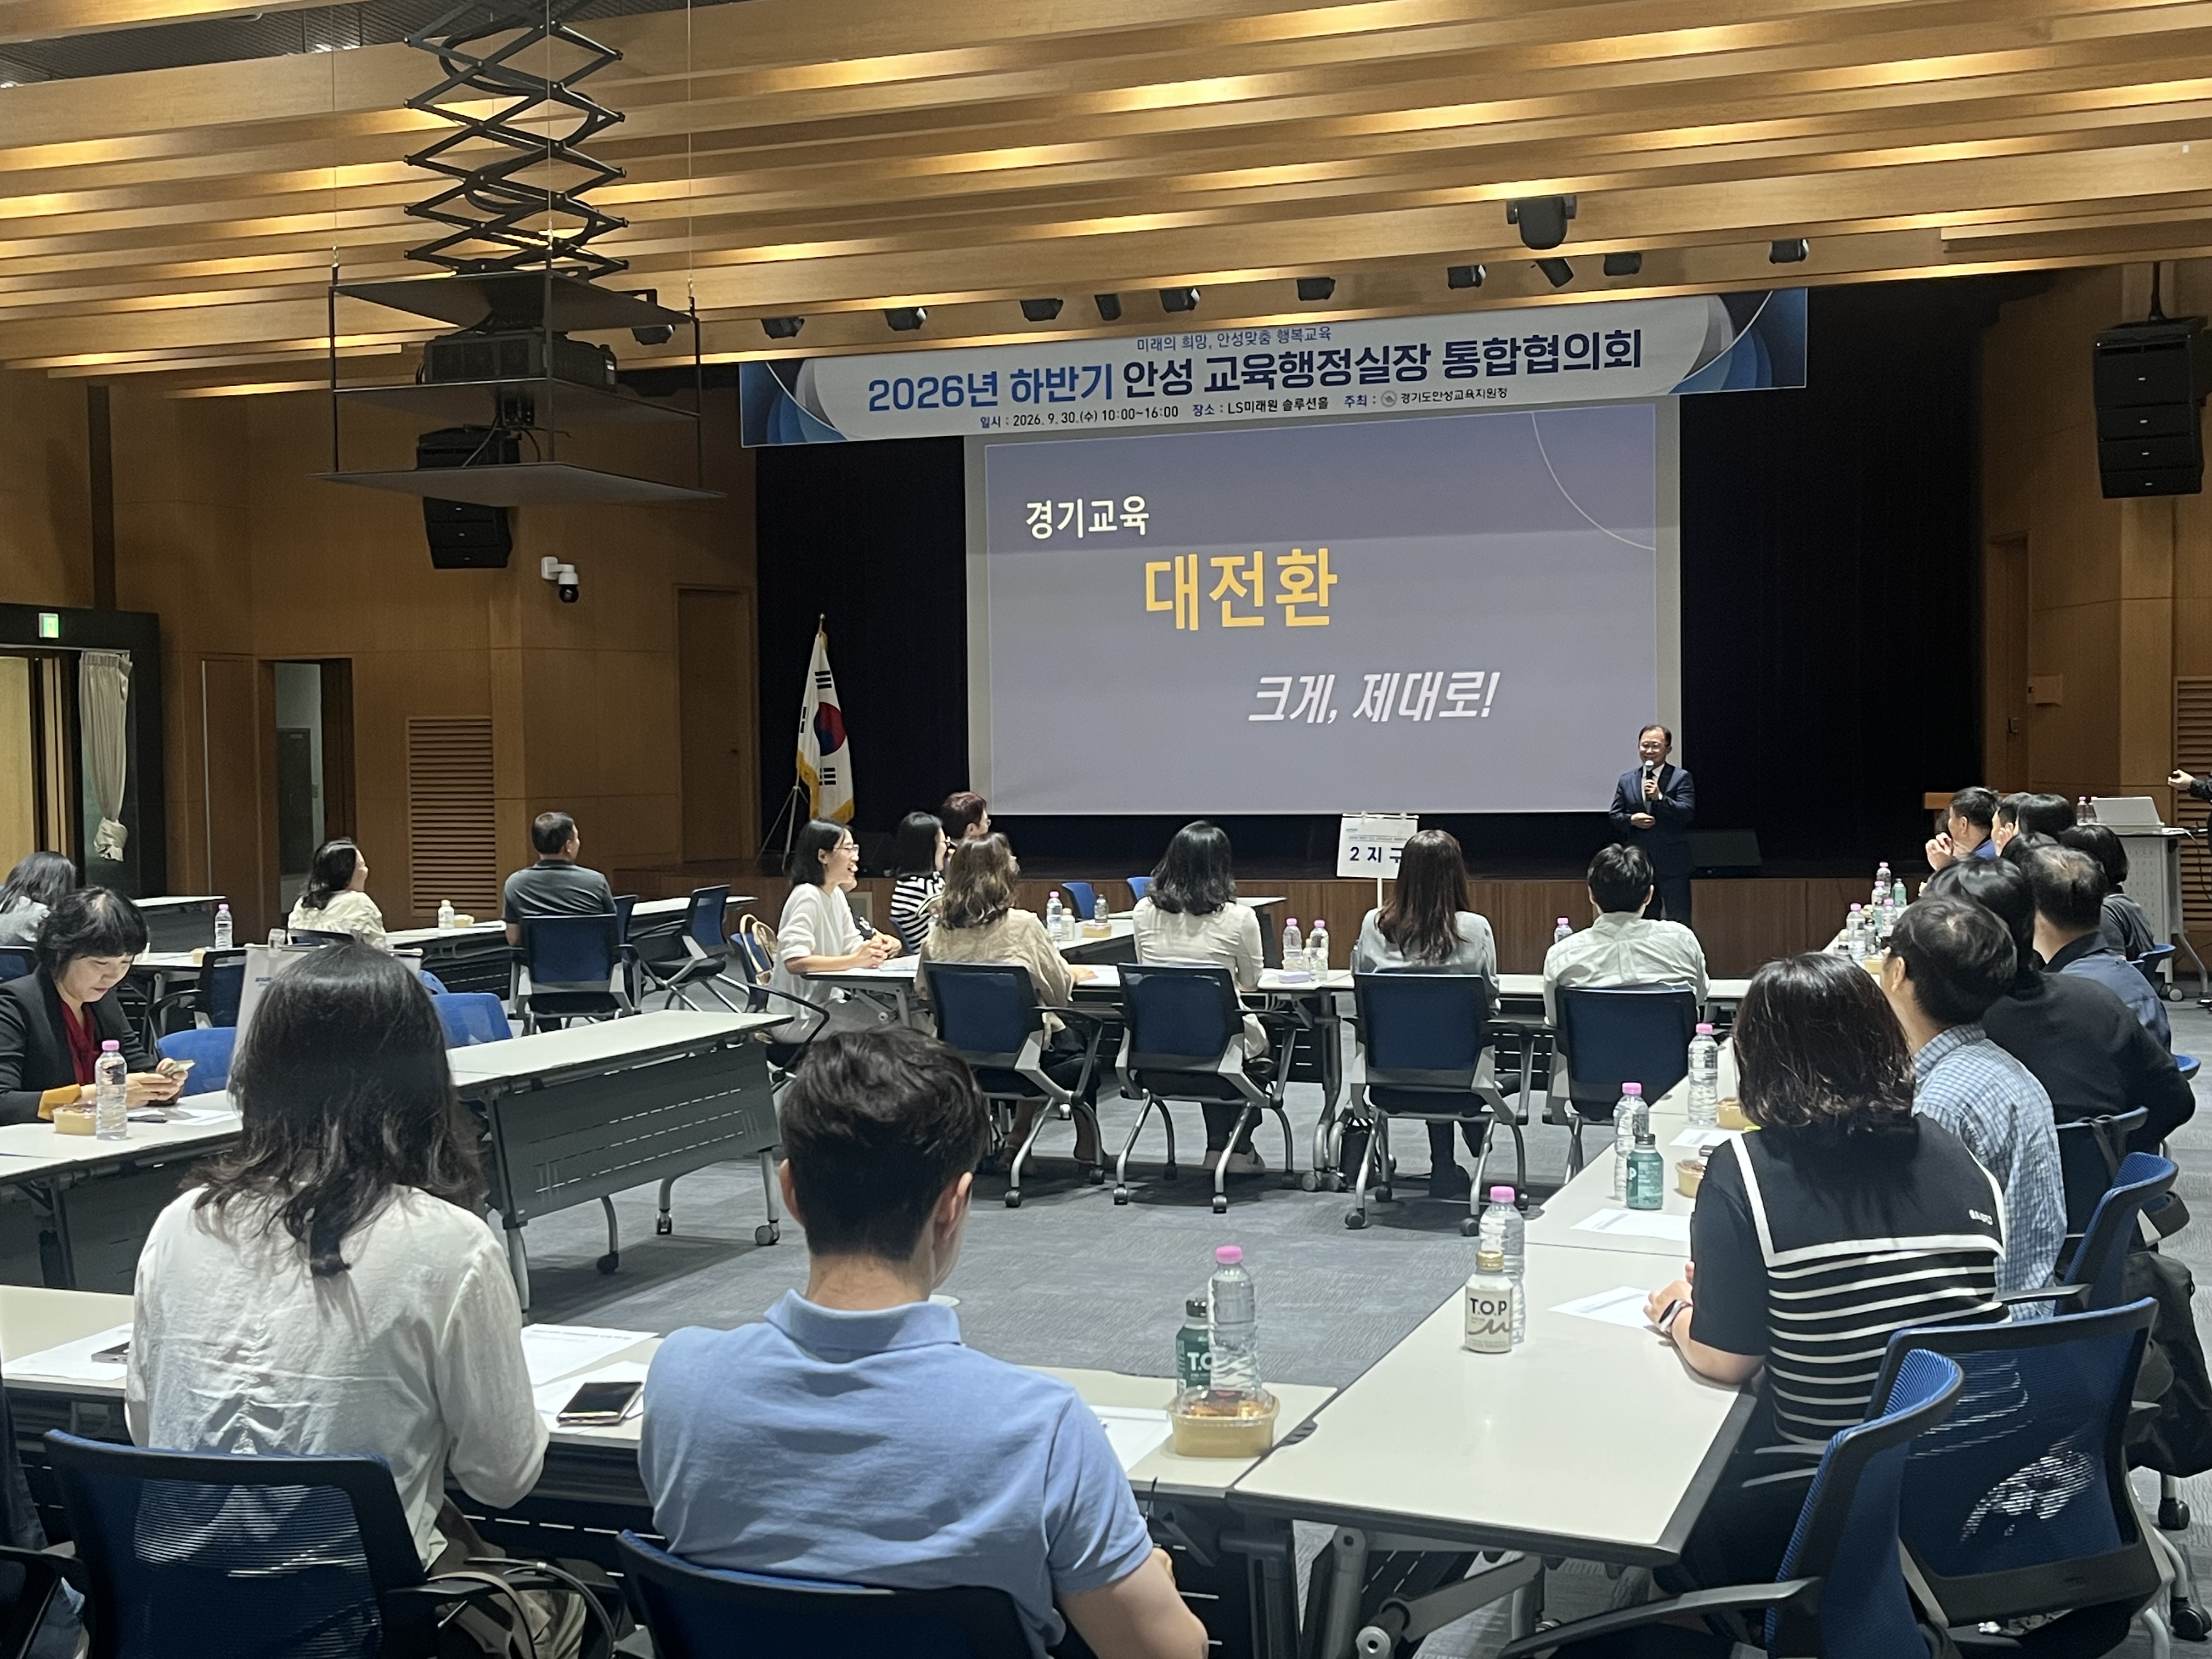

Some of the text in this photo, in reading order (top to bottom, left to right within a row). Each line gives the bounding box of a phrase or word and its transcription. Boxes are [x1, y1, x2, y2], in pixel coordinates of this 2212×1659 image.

[1137, 325, 1332, 352] 미래의 희망, 안성맞춤 행복교육
[868, 329, 1641, 411] 2026년 하반기 안성 교육행정실장 통합협의회
[980, 416, 1001, 428] 일시
[1102, 405, 1179, 421] 10:00~16:00
[1192, 403, 1215, 417] 장소
[1228, 399, 1278, 414] LS미래원
[1282, 396, 1329, 411] 솔루션홀
[1344, 393, 1368, 408] 주최
[1400, 387, 1508, 404] 경기도안성교육지원청
[1025, 495, 1150, 540] 경기교육
[1145, 548, 1339, 631] 대전환
[1248, 671, 1501, 725] 크게, 제대로!
[1469, 1297, 1508, 1316] T.O.P
[1187, 1352, 1212, 1371] T.O
